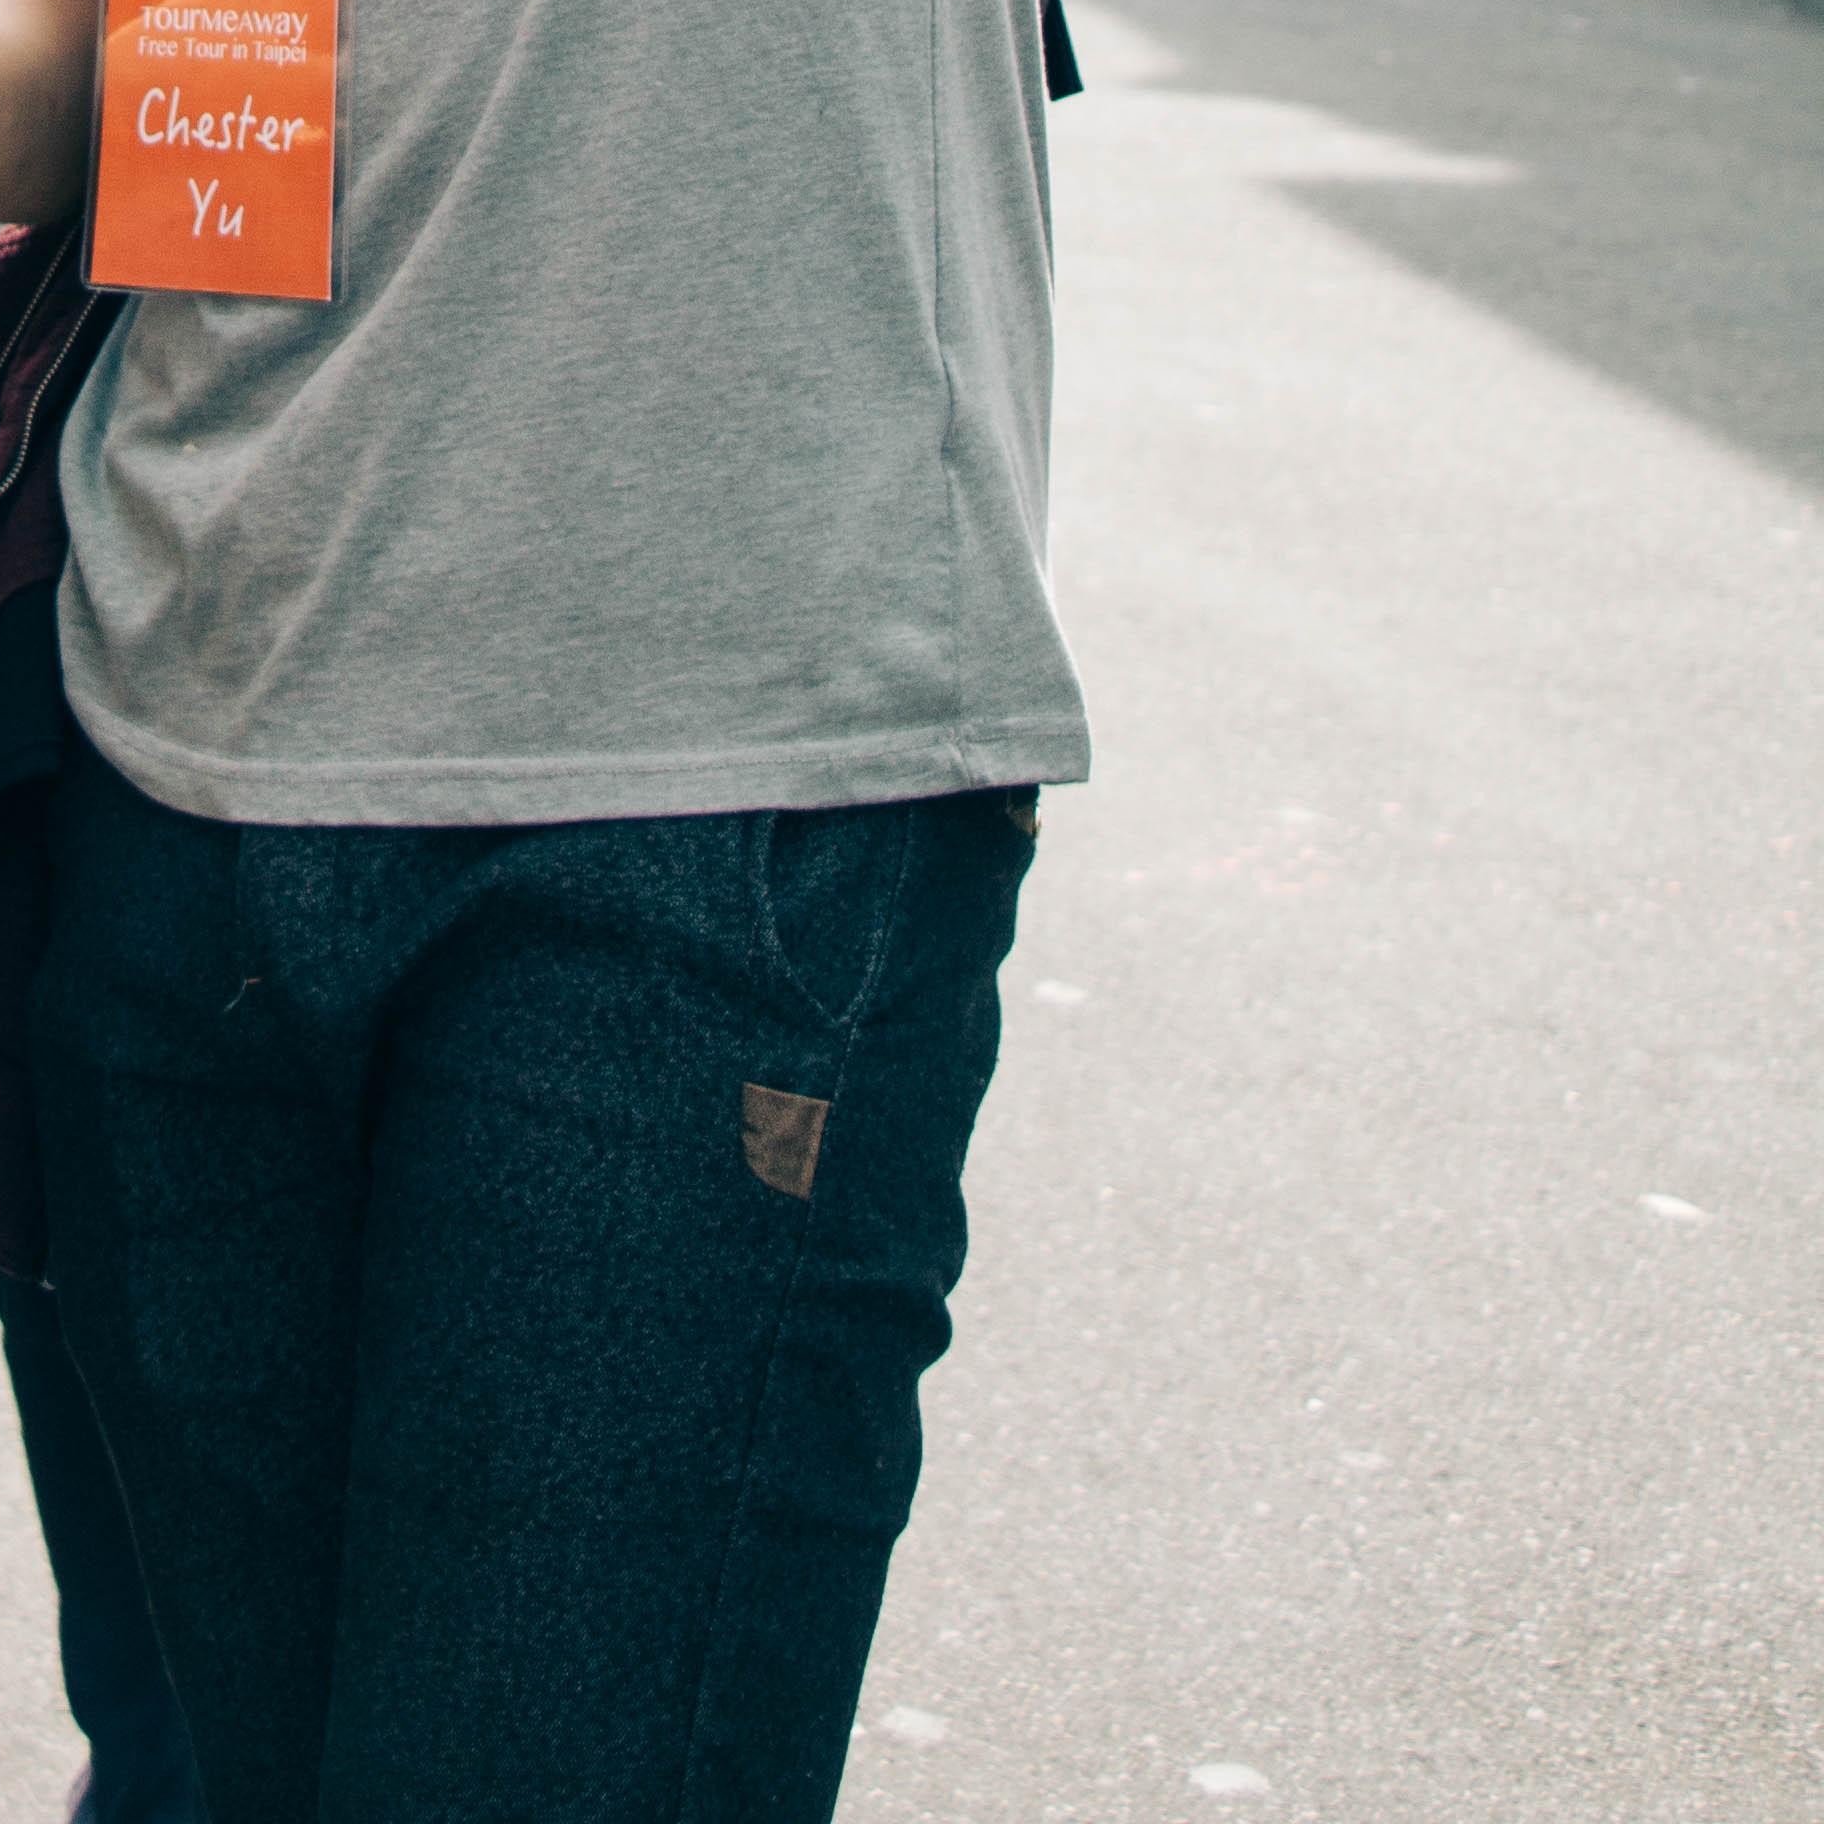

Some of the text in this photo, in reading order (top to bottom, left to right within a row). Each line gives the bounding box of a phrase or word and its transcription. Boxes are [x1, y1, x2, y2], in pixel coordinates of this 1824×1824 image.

[138, 36, 307, 68] Free Tour in Taipei
[137, 87, 304, 153] Chester
[189, 178, 243, 237] Yu
